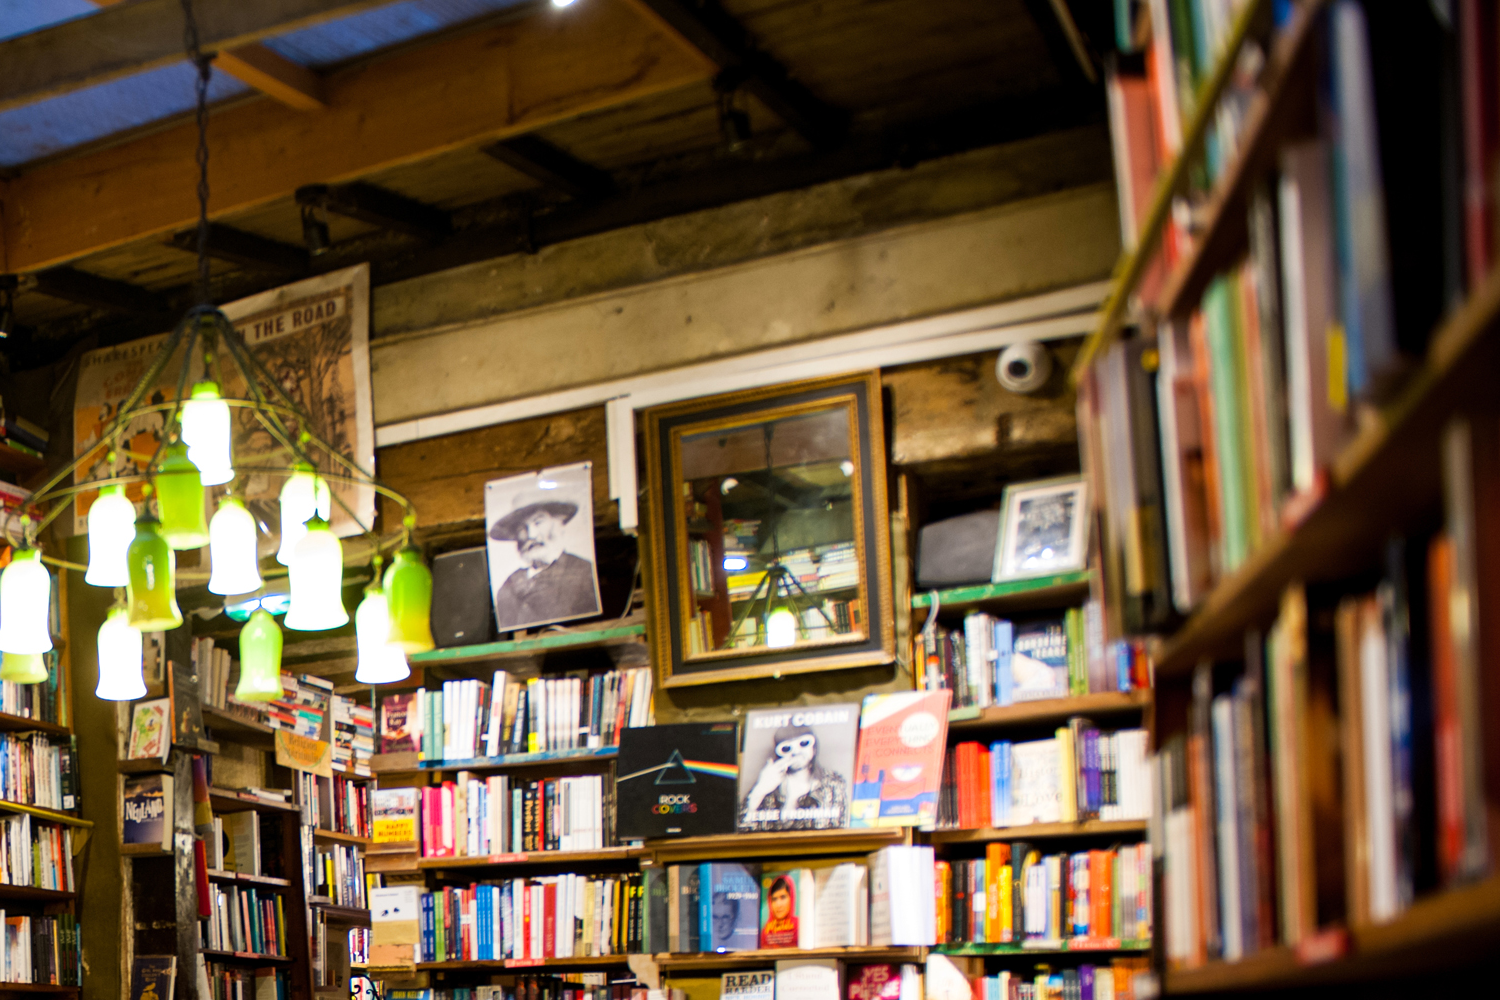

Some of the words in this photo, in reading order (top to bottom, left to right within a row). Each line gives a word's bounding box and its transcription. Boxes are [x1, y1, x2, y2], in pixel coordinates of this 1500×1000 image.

[254, 320, 285, 339] THE
[292, 301, 337, 328] ROAD
[752, 713, 790, 729] KURT
[792, 709, 850, 728] COBAIN
[659, 794, 691, 805] ROCK
[651, 802, 698, 815] COVERS
[781, 807, 841, 821] FROHMAN
[725, 972, 773, 988] READ
[862, 965, 890, 983] YES
[392, 990, 409, 1000] JOHN
[725, 985, 771, 996] HARDER
[849, 978, 900, 1000] PLEASE
